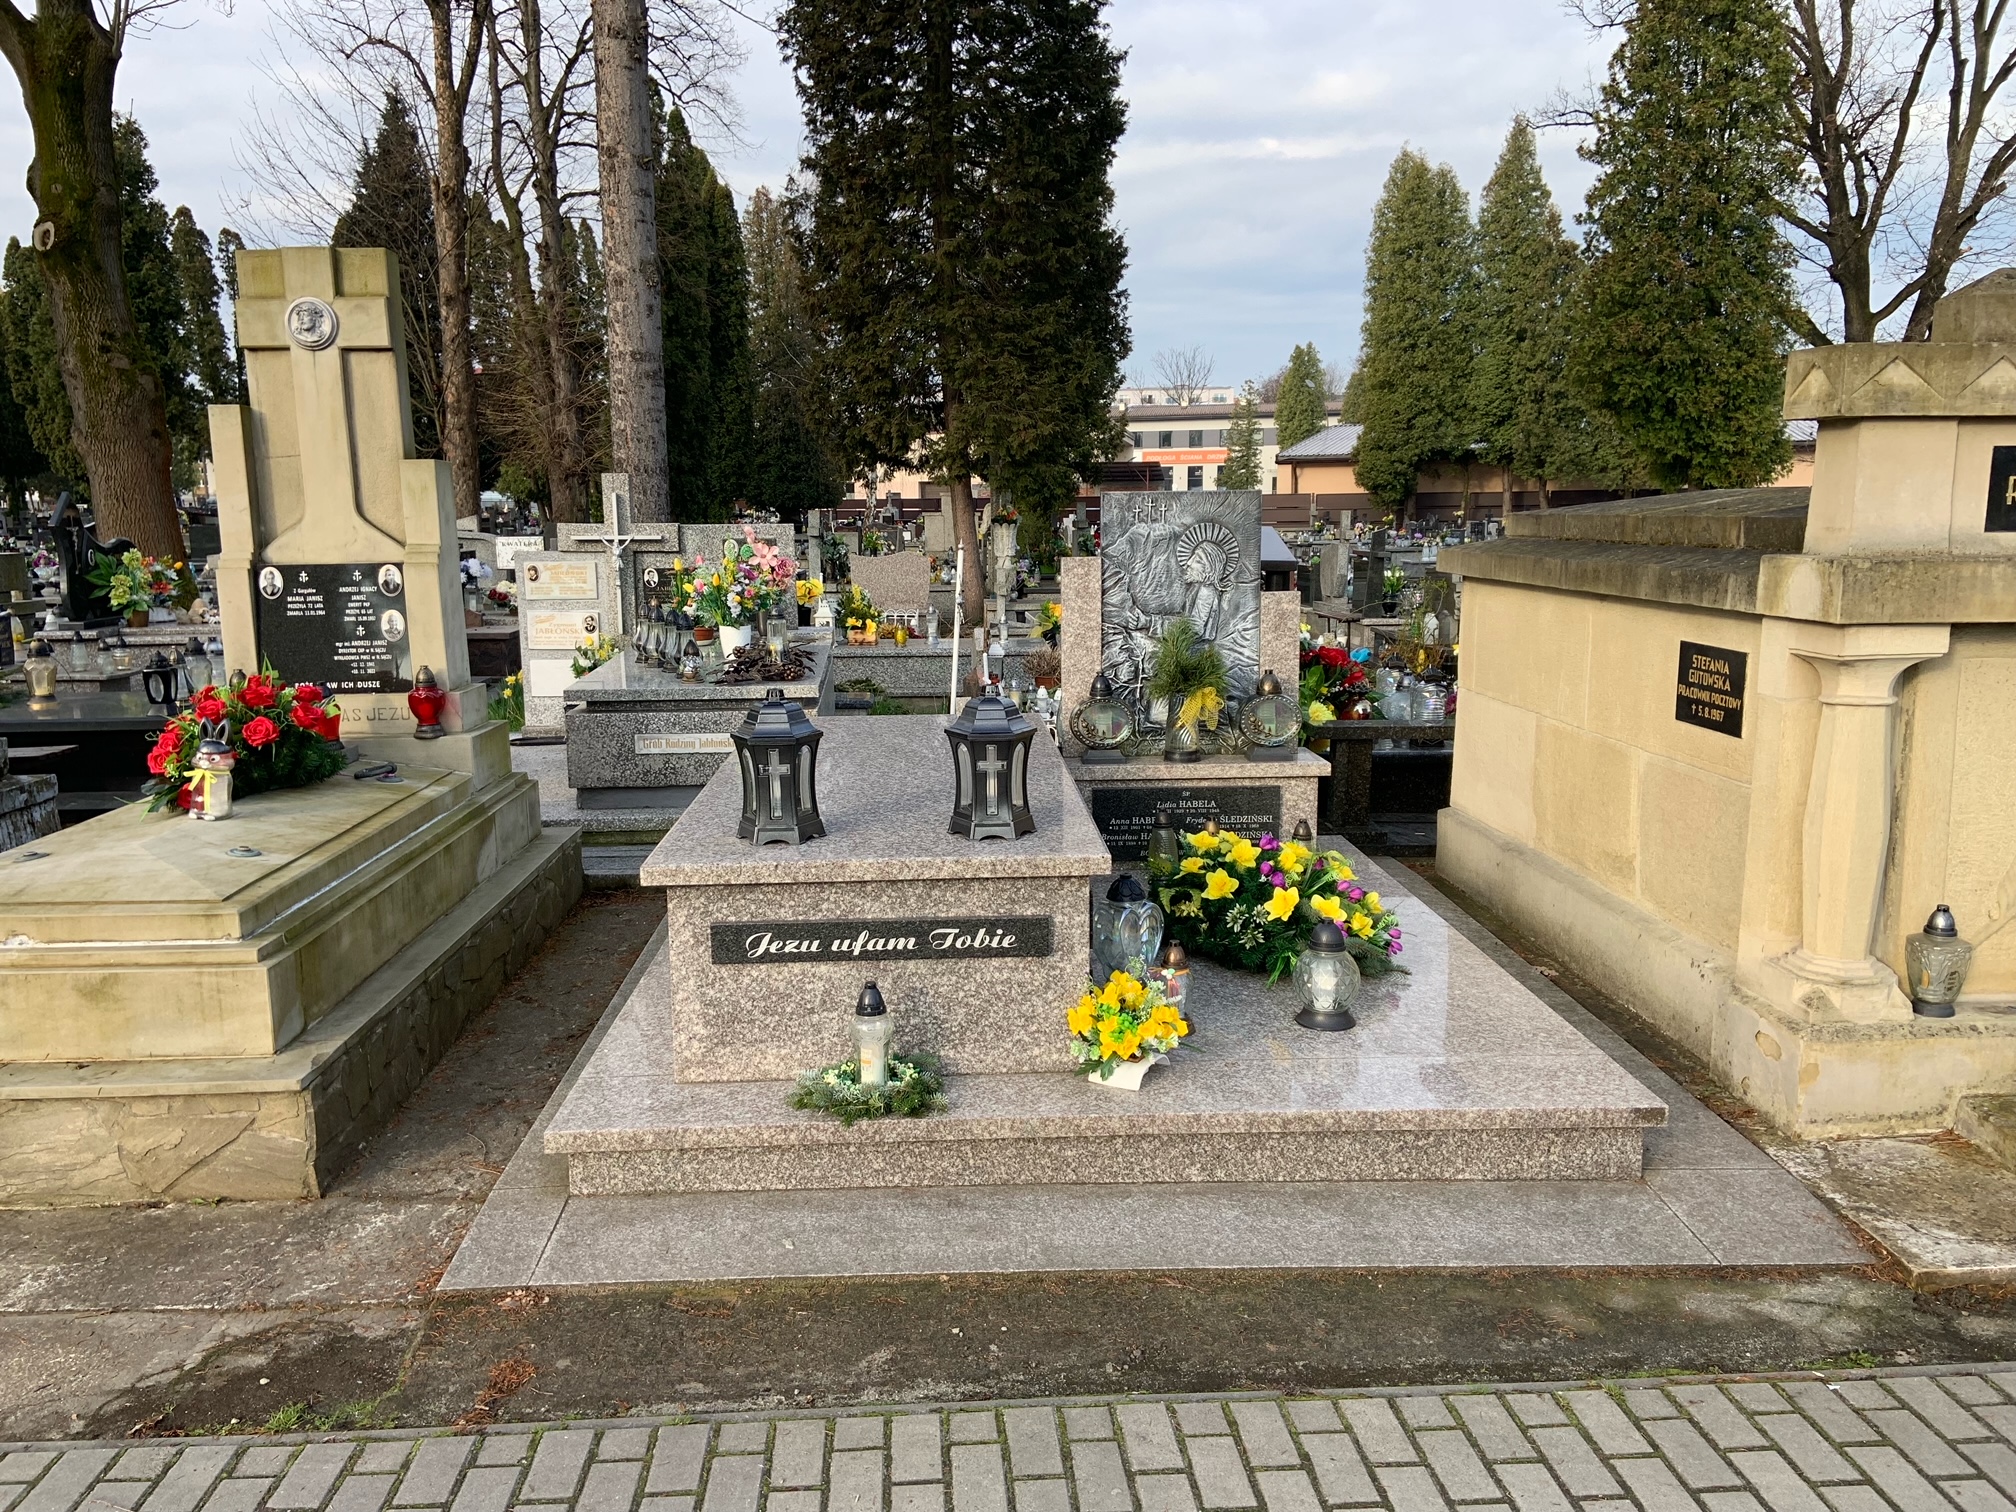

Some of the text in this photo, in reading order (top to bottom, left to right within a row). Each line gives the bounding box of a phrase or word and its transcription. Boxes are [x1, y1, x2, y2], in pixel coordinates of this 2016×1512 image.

[1692, 654, 1729, 675] STEFANIA
[357, 680, 380, 688] DUSZE
[1688, 668, 1730, 691] GUTOWSKA
[1710, 692, 1741, 710] POCZTOWY
[643, 738, 662, 749] Grób
[666, 738, 695, 749] Rodziny
[1179, 800, 1216, 808] HABELA
[1220, 814, 1273, 823] ŚLEDZIŃSKI
[745, 928, 1017, 957] Jezu ufam Tobie
